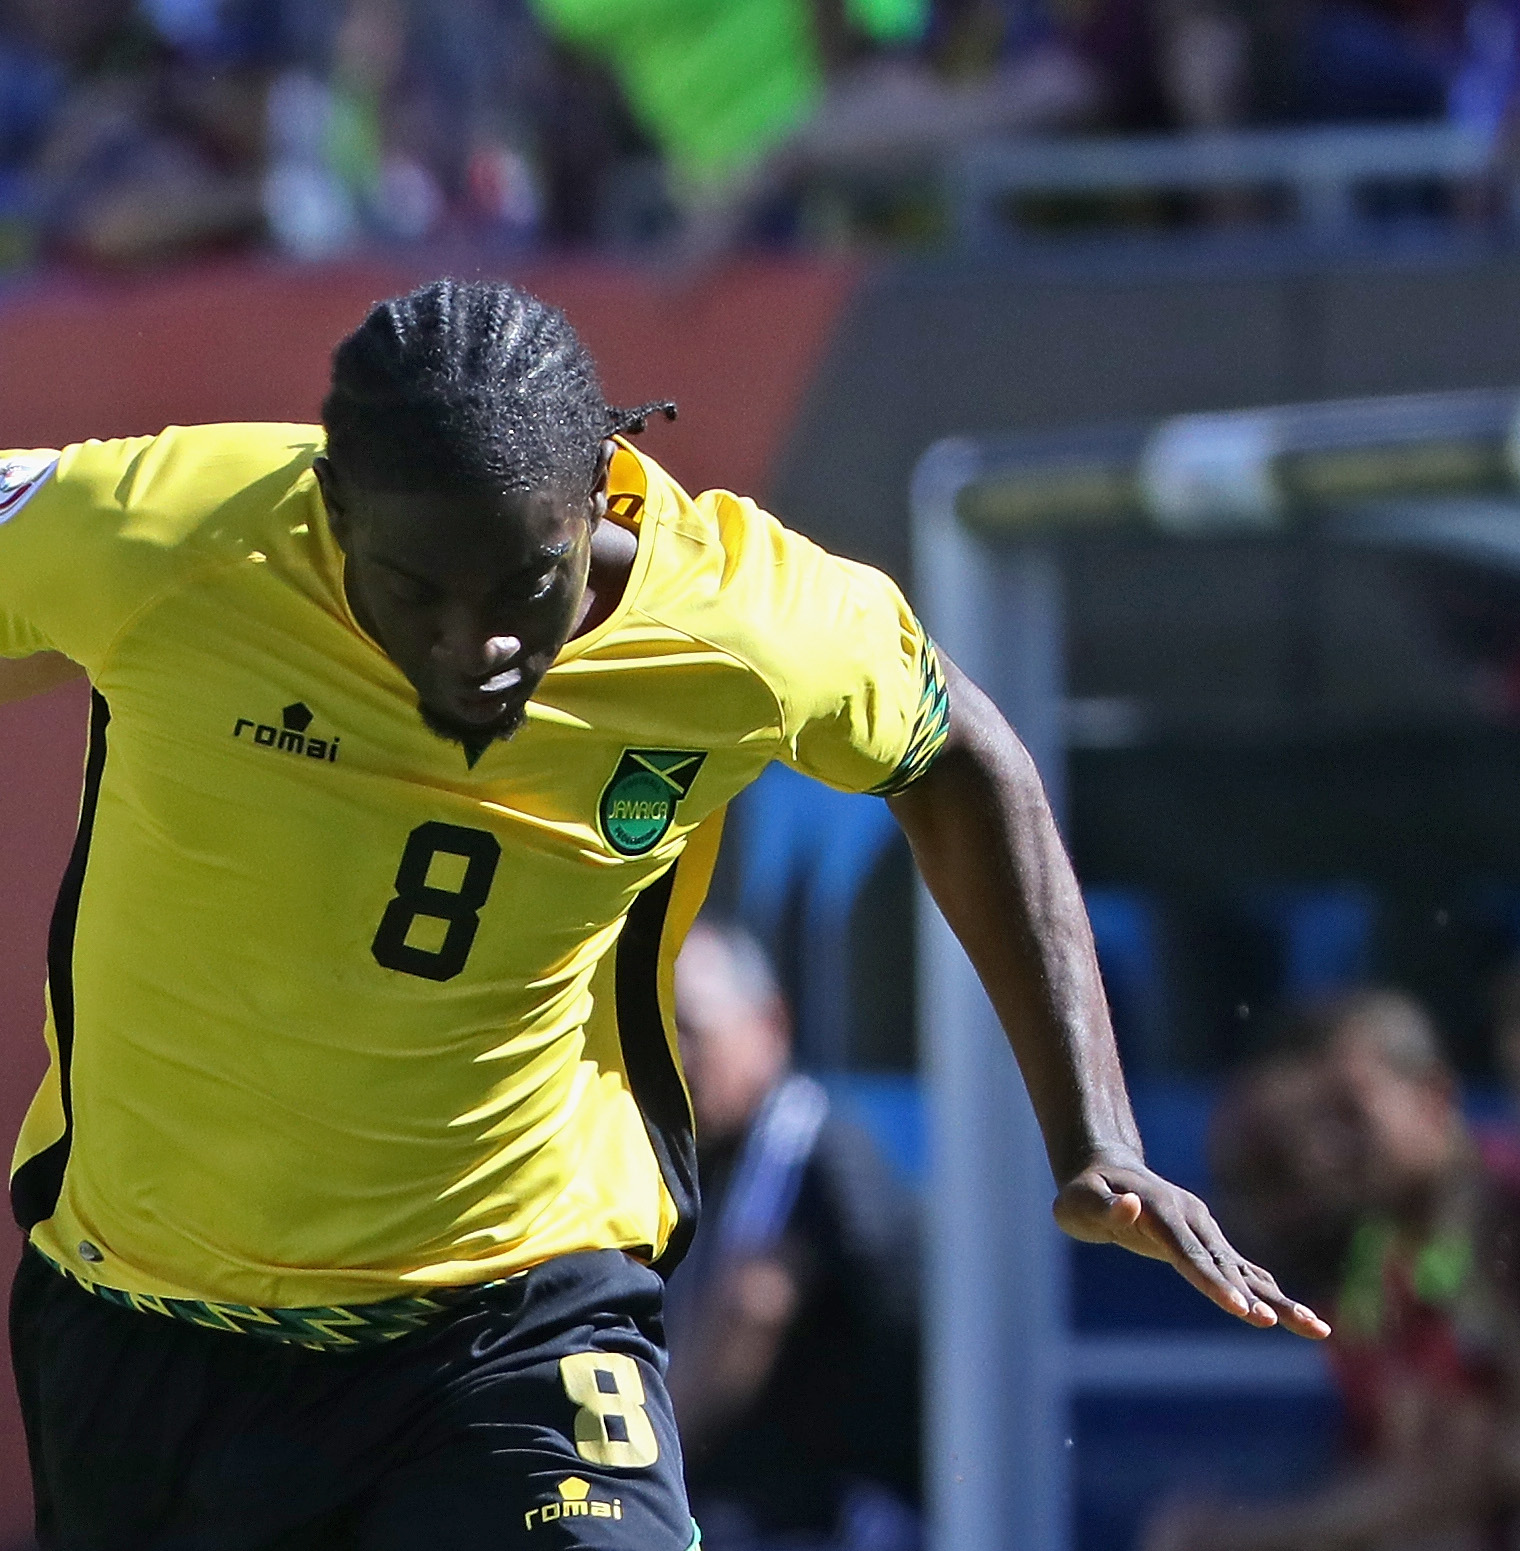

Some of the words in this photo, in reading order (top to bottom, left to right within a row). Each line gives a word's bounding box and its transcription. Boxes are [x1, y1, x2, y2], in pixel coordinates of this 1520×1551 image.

[233, 717, 341, 763] romai
[607, 800, 669, 820] JAMAICA
[370, 820, 502, 983] 8
[560, 1352, 659, 1468] 8
[524, 1498, 623, 1532] romai
